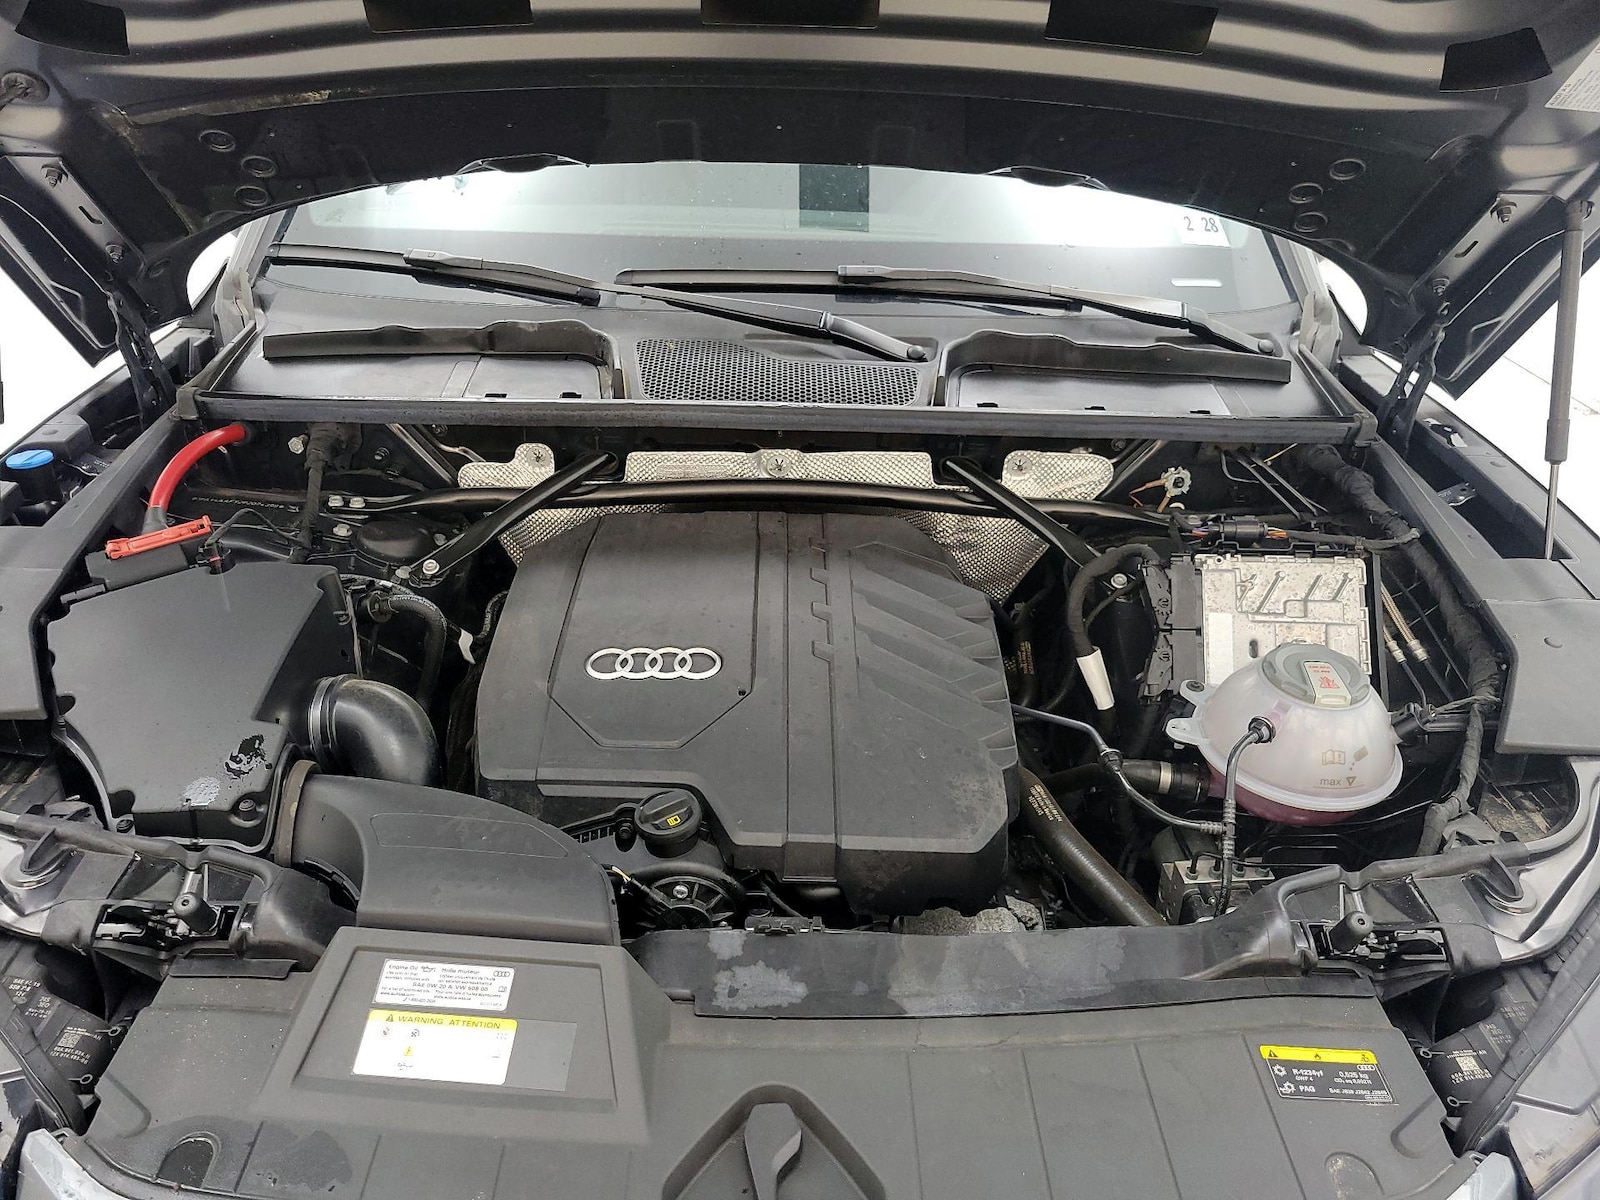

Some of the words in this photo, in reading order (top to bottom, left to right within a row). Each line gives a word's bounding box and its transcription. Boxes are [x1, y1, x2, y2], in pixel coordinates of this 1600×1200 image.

[1184, 216, 1194, 231] 2
[1201, 217, 1218, 232] 28
[398, 1016, 444, 1026] WARNING
[449, 1019, 500, 1029] ATTENTION
[1292, 1068, 1324, 1078] R-1234yf
